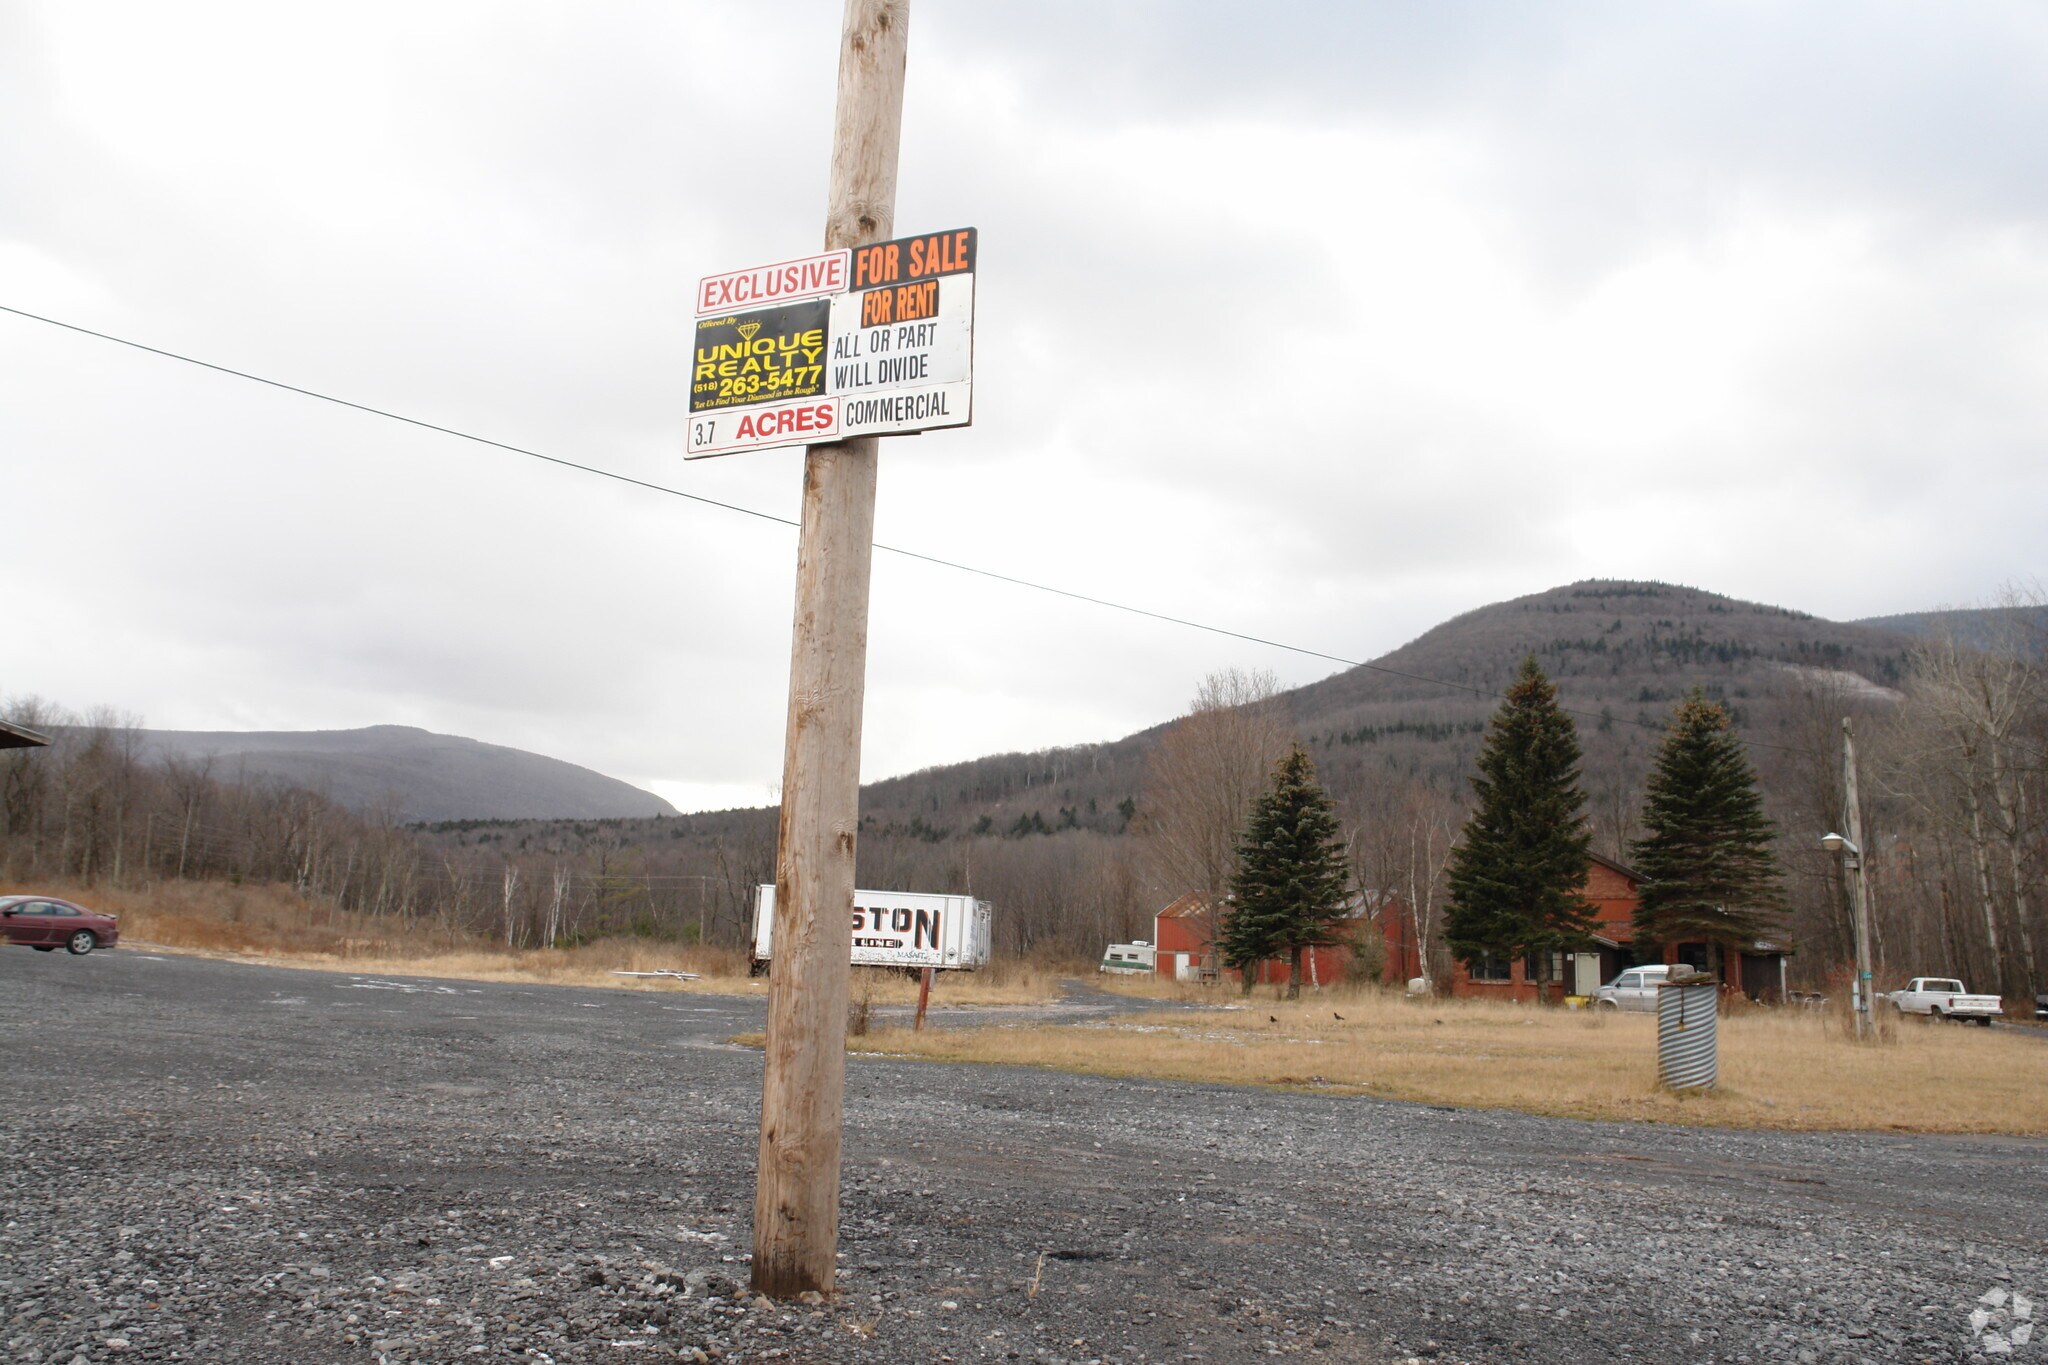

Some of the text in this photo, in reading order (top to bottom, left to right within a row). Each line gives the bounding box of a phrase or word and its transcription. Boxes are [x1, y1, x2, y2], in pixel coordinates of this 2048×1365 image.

[856, 231, 968, 287] FOR SALE
[703, 258, 841, 307] EXCLUSIVE
[863, 281, 937, 324] FOR RENT
[699, 316, 737, 329] Offered By
[697, 329, 822, 363] UNIQUE
[834, 323, 937, 360] ALL OR PART
[694, 365, 822, 397] (518) 263-5477
[695, 347, 824, 381] REALTY
[835, 354, 928, 390] WILL DIVIDE
[706, 398, 714, 406] Us
[715, 397, 729, 406] Find
[731, 394, 746, 403] Your
[747, 390, 775, 402] Diamond
[776, 389, 782, 397] in
[783, 387, 793, 396] the
[846, 391, 950, 427] COMMERCIAL
[695, 404, 834, 446] 3.7 ACRES
[852, 907, 941, 950] STON
[861, 938, 894, 948] LINE
